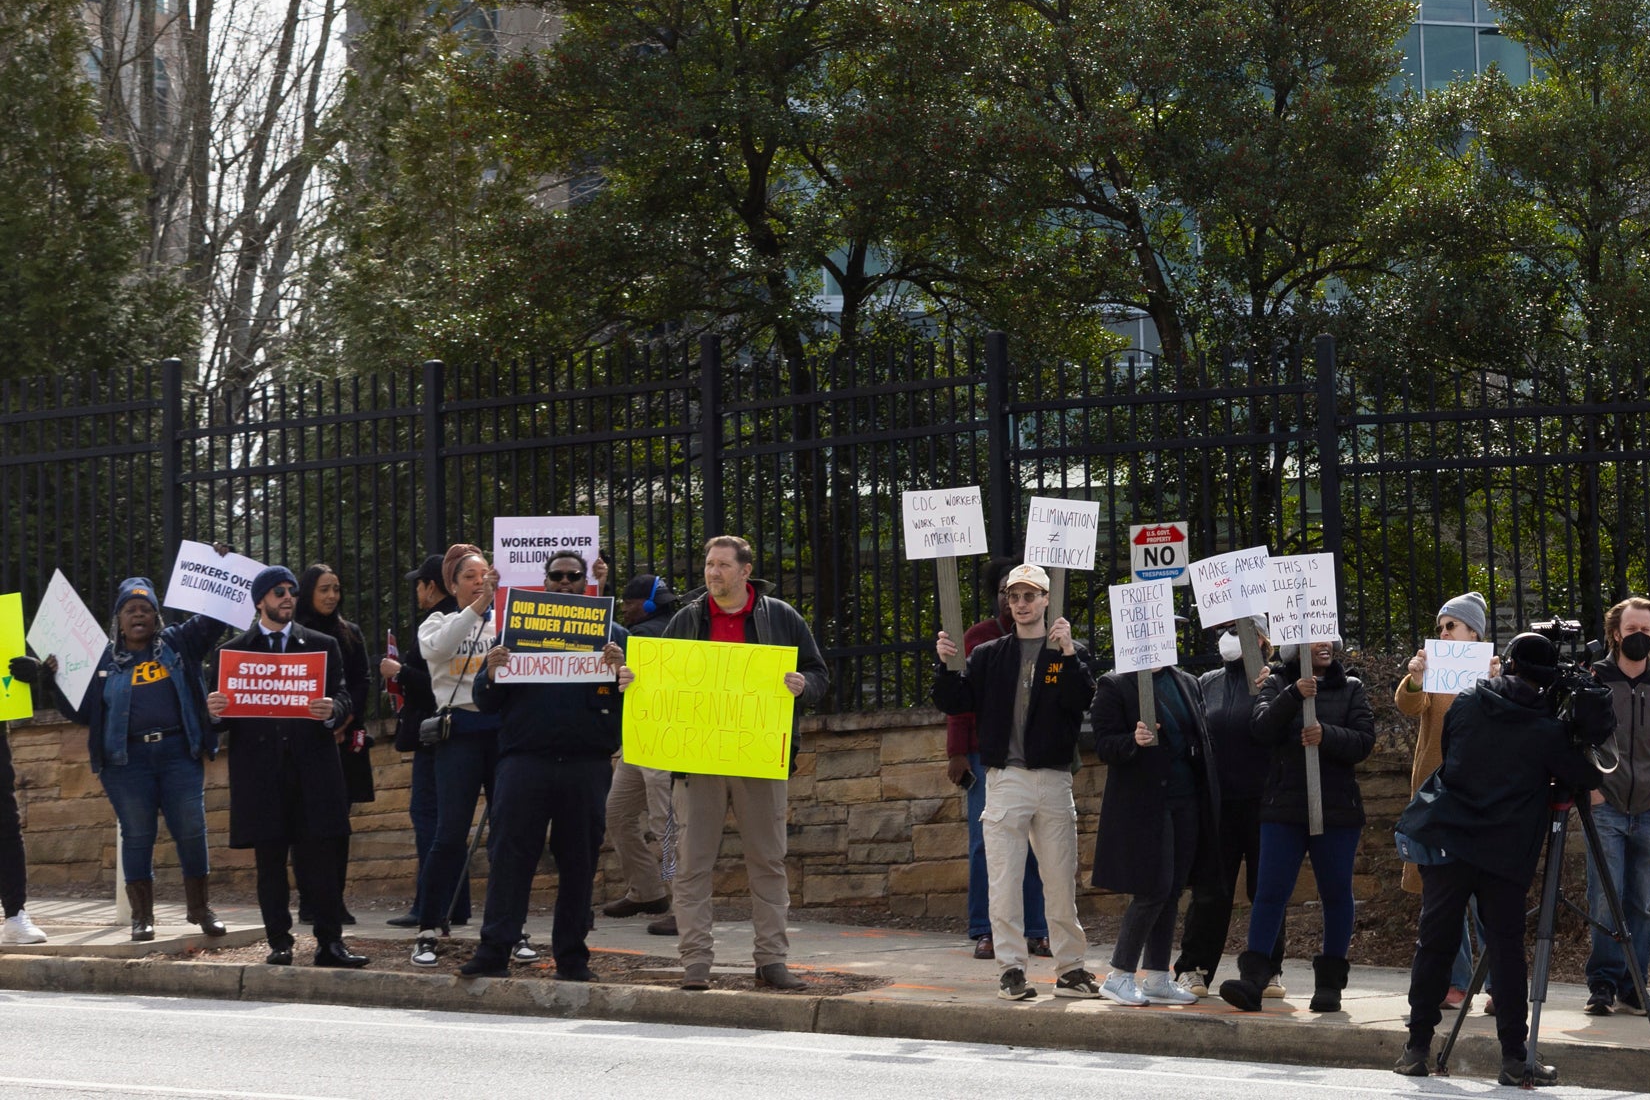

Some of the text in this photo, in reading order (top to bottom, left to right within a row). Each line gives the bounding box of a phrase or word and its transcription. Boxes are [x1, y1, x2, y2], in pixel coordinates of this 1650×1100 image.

[912, 496, 937, 511] CDC
[912, 515, 959, 530] WORK FOR
[1031, 506, 1097, 530] ELIMINATION
[501, 536, 592, 547] WORKERS OVER
[924, 526, 972, 548] AMERICA!
[1028, 545, 1091, 569] EFFICIENCY!
[1143, 545, 1175, 567] NO
[180, 560, 230, 581] WORKERS
[1141, 569, 1179, 578] TRESPASSING
[1198, 560, 1229, 582] MAKE
[1273, 558, 1318, 574] THIS IS
[180, 574, 247, 604] BILLIONAIRES!
[1121, 583, 1165, 604] PROTECT
[1272, 577, 1317, 591] ILLEGAL
[1202, 588, 1233, 609] GREAT
[1286, 593, 1328, 609] AF and
[512, 600, 607, 622] OUR DEMOCRACY
[1120, 603, 1164, 623] PUBLIC
[1272, 611, 1337, 624] not to mention
[510, 615, 606, 636] IS UNDER ATTACK
[1126, 621, 1165, 640] HEALTH
[1279, 622, 1338, 641] VERY RUDE!
[1131, 652, 1161, 666] SUFFER
[1434, 641, 1479, 659] DUE
[238, 663, 308, 676] STOP THE
[637, 640, 797, 694] PROTECT
[227, 677, 317, 692] BILLIONAIRE
[234, 692, 309, 706] TAKEOVER
[631, 685, 788, 730] GOVERNMENT
[634, 724, 787, 768] WORKERS!
